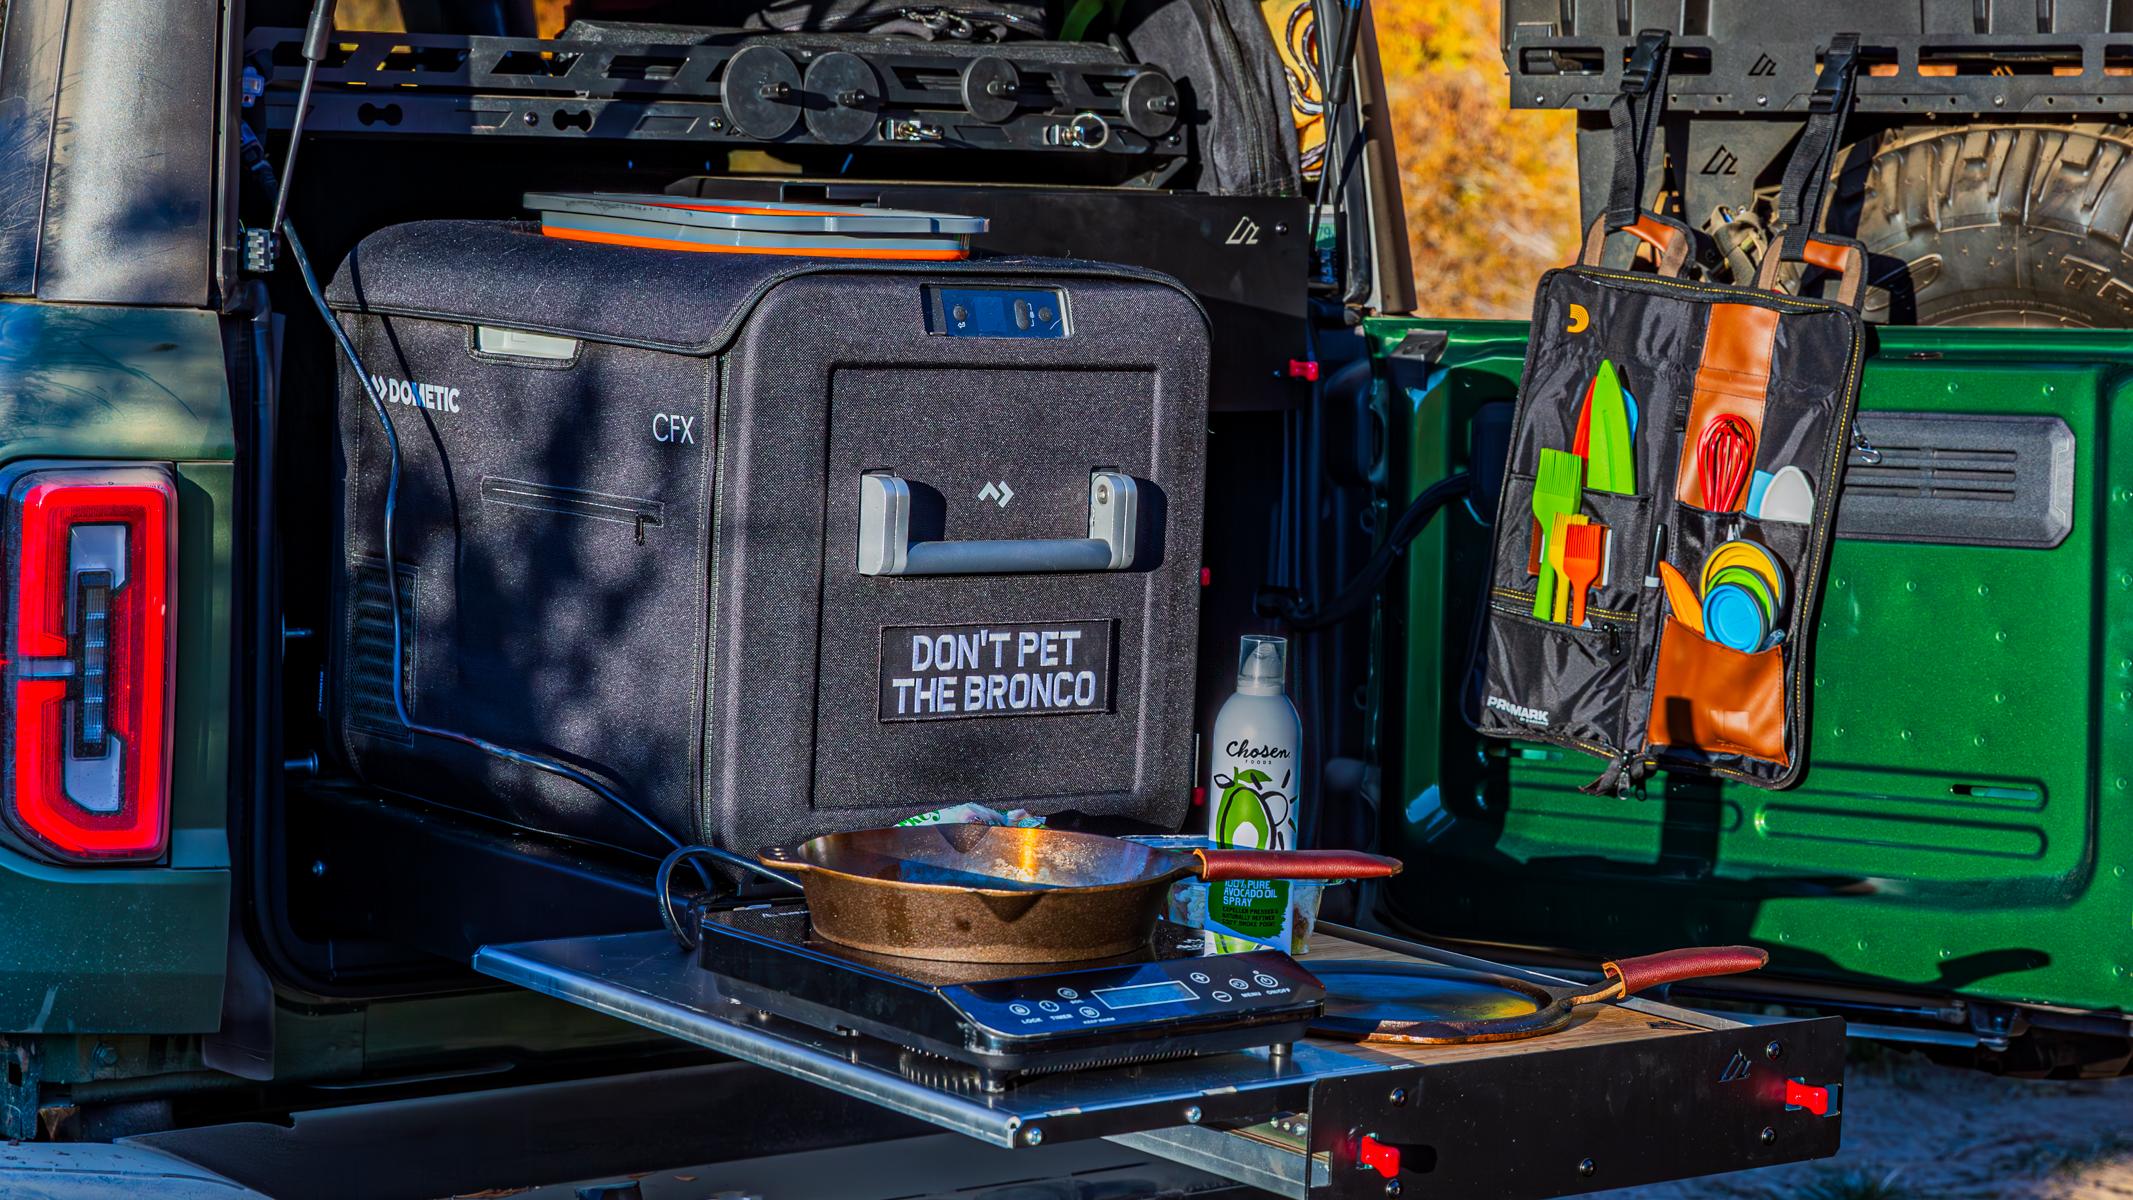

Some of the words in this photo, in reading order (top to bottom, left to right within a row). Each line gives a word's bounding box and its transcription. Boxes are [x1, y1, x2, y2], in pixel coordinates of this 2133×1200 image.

[389, 378, 460, 413] DOMETIC
[653, 413, 694, 444] CFX
[911, 629, 1011, 672] DON'T
[1017, 630, 1082, 667] PET
[892, 676, 958, 714] THE
[964, 670, 1097, 712] BRONCO
[1226, 739, 1291, 759] Chosen
[1223, 887, 1264, 899] AVOCADO
[1264, 889, 1278, 899] OIL
[1247, 880, 1271, 890] PURE
[1223, 895, 1253, 907] SPRAY
